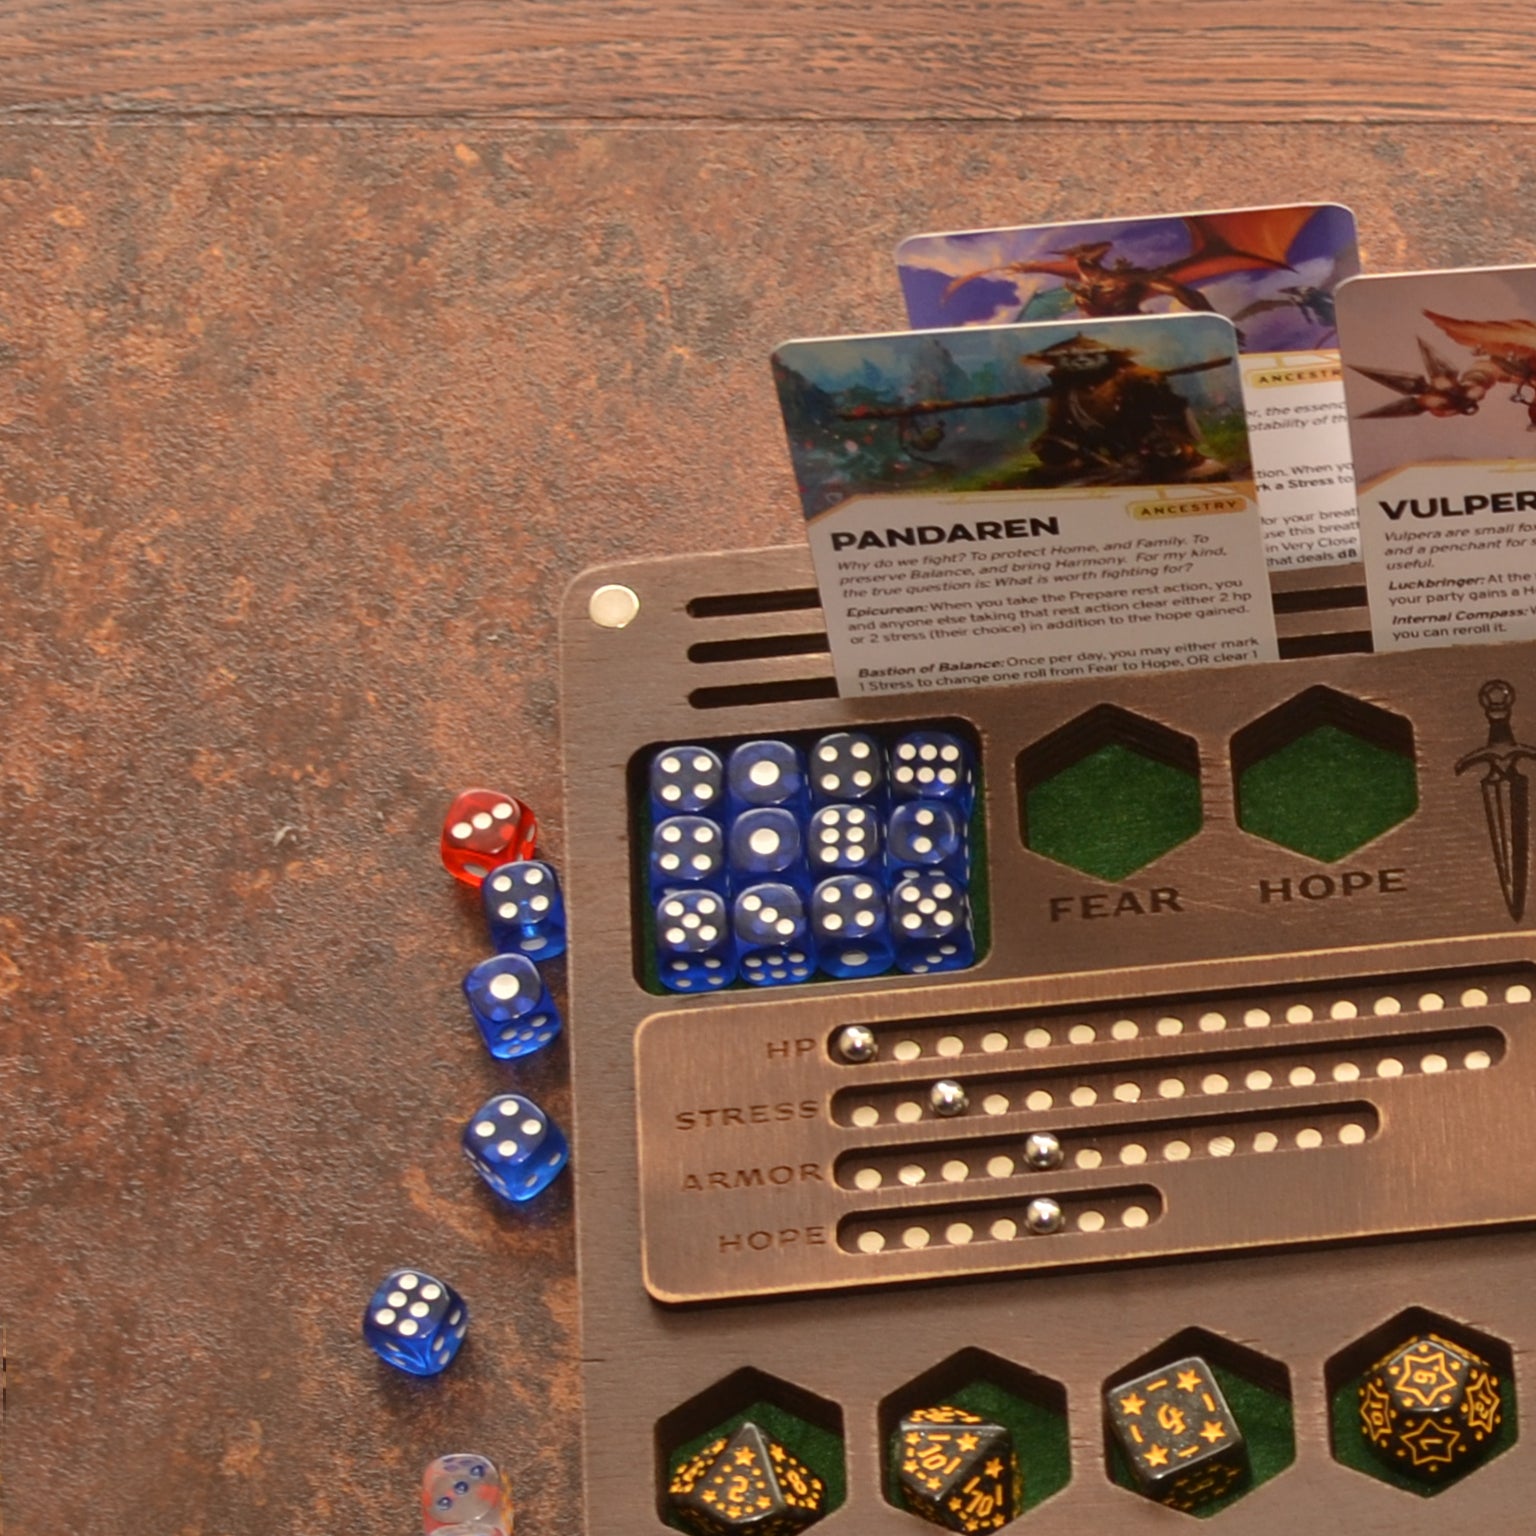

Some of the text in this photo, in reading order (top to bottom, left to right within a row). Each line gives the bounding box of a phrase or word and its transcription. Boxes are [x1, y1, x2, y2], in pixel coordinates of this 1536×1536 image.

[1258, 369, 1342, 383] ANCESTR
[1140, 500, 1236, 516] ANCESTRY
[830, 517, 1059, 550] PANDAREN
[1265, 536, 1357, 553] in Very Close
[1295, 548, 1357, 564] deals d8
[1388, 576, 1486, 591] Luckbringer:
[1487, 573, 1503, 584] At
[1506, 572, 1532, 583] the
[1388, 595, 1422, 607] your
[1425, 591, 1465, 604] party
[1468, 589, 1508, 602] gains
[1510, 587, 1520, 597] a
[1391, 611, 1452, 625] Internal
[1455, 608, 1529, 621] Compass:
[1391, 622, 1507, 642] you can reroll it.
[858, 650, 1259, 692] 1 Stress to change one roll from Fear to Hope, OR clear 1
[1259, 868, 1408, 903] HOPE
[1049, 887, 1184, 922] FEAR
[766, 1038, 816, 1059] HP
[675, 1100, 819, 1131] STRESS
[682, 1163, 823, 1191] ARMOR
[719, 1226, 827, 1253] HOPE
[728, 1475, 748, 1502] 2
